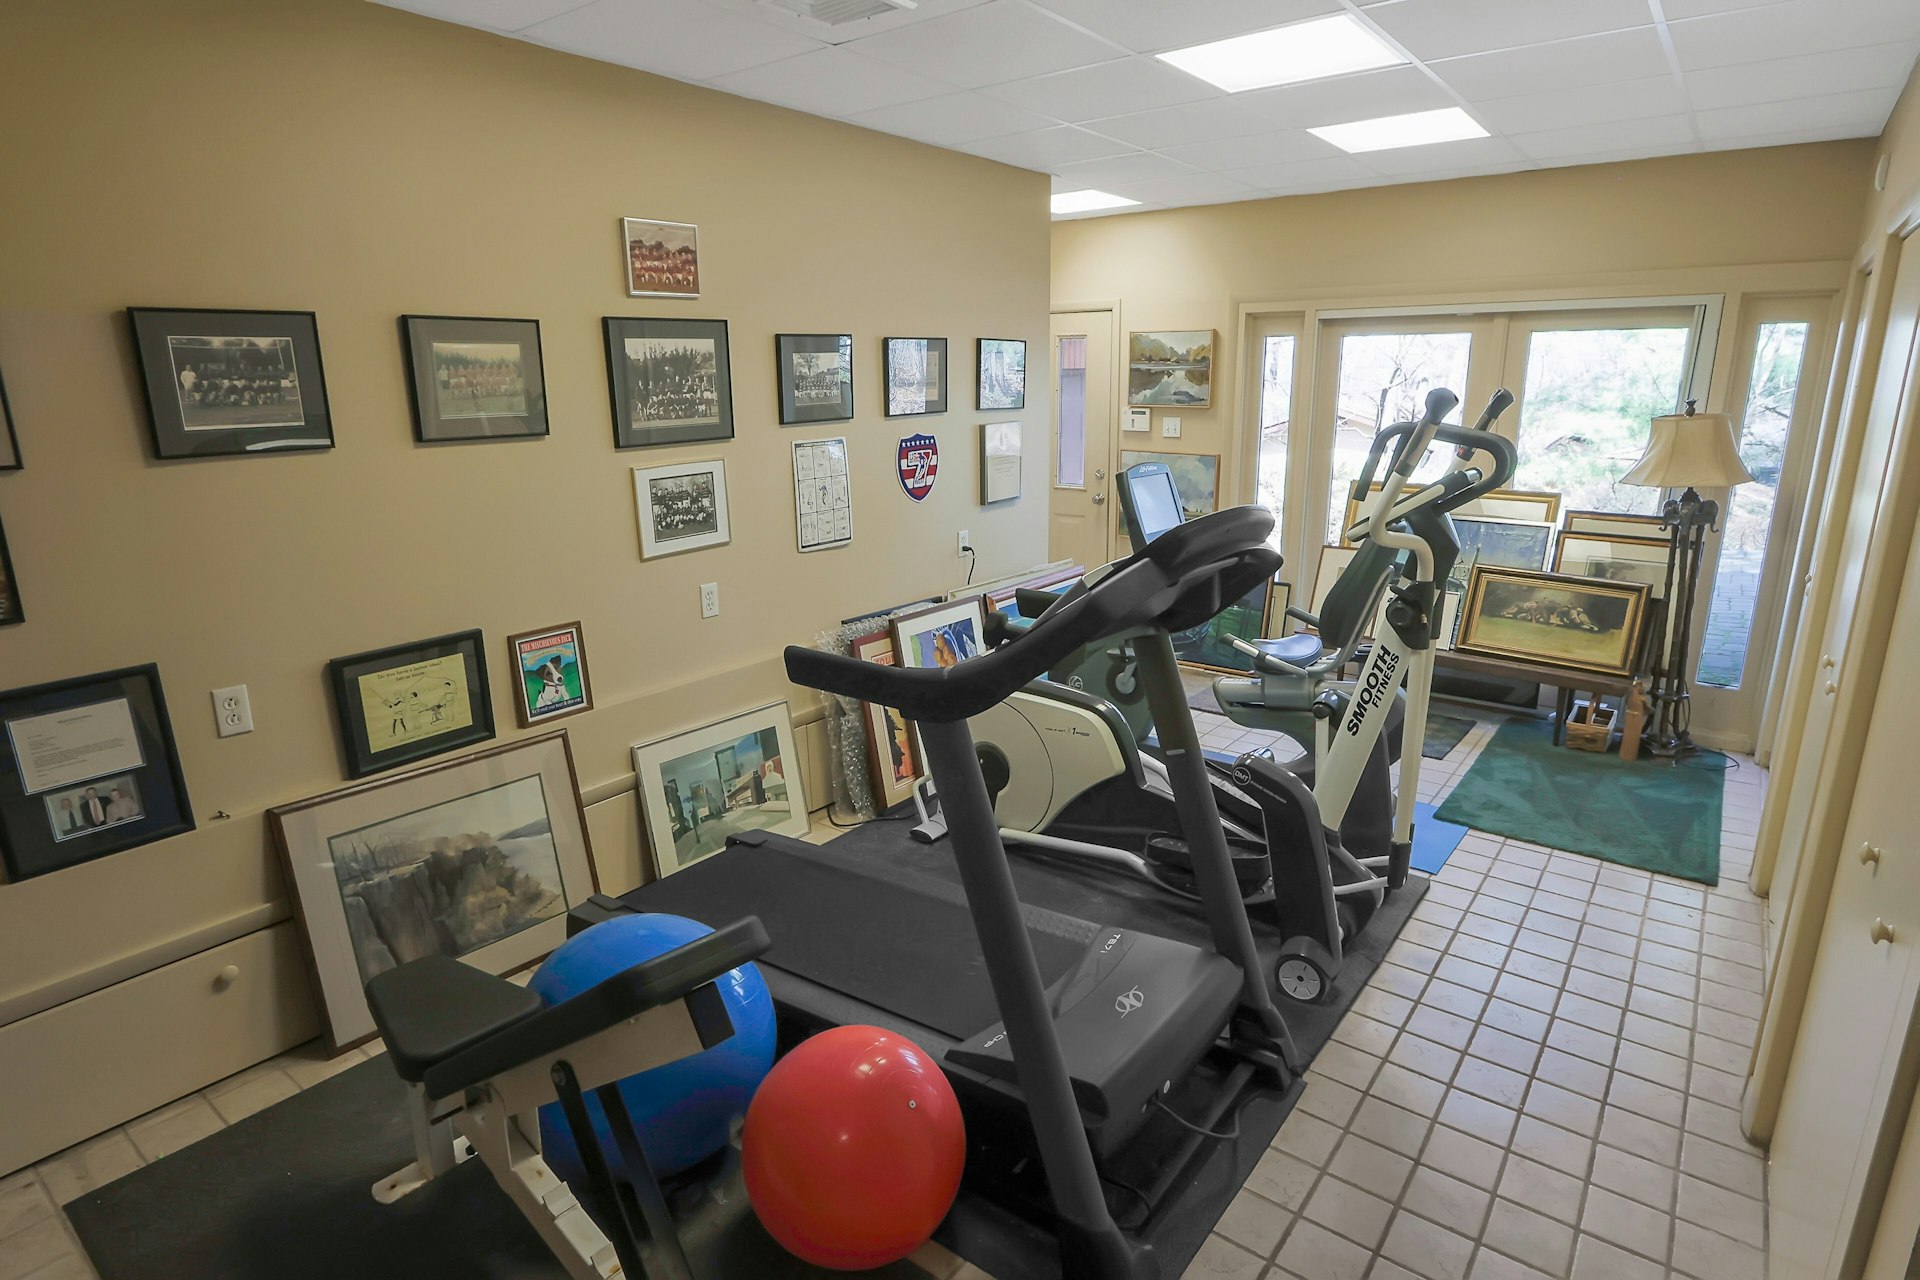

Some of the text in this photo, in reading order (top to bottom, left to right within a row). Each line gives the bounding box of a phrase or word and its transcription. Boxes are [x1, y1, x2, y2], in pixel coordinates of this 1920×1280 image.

[1347, 644, 1391, 736] SMOOTH
[1371, 653, 1400, 708] FITNESS
[1234, 770, 1249, 782] DMT
